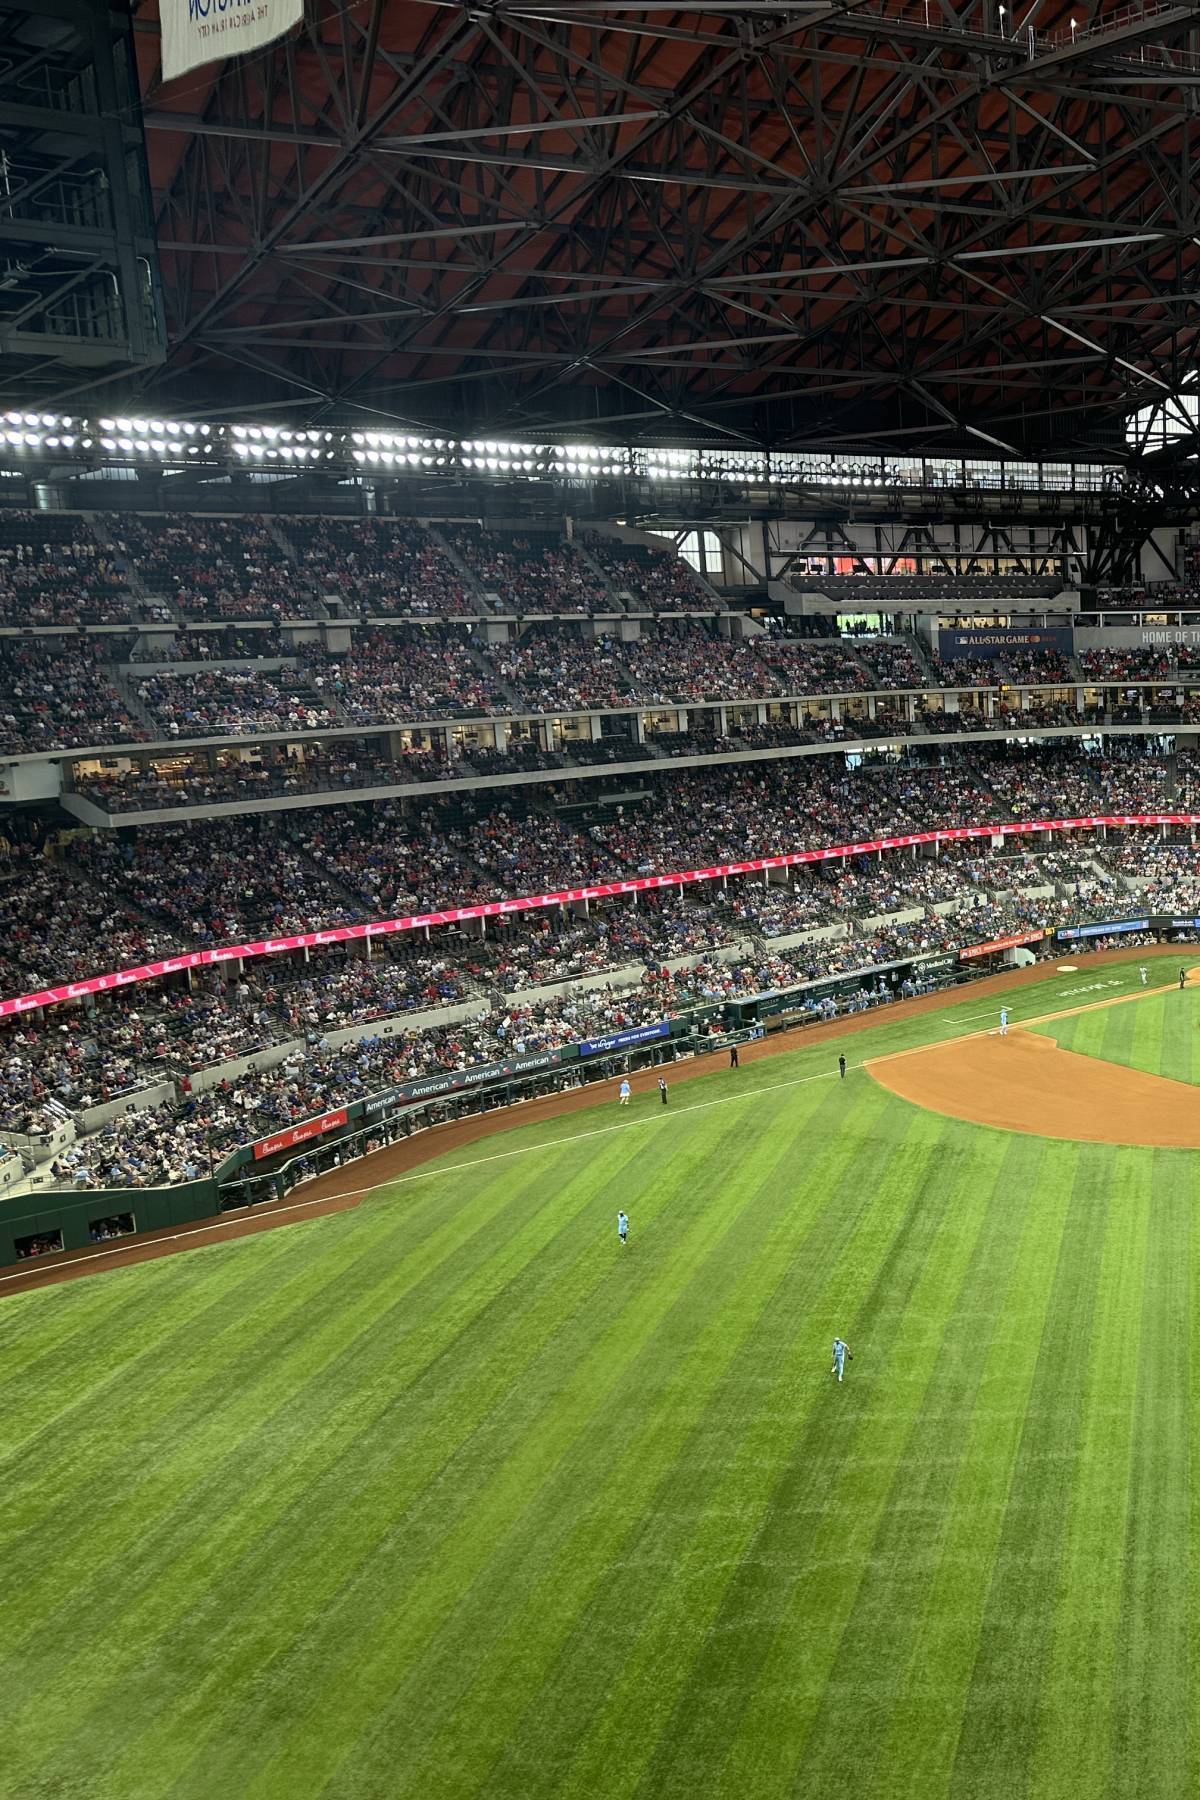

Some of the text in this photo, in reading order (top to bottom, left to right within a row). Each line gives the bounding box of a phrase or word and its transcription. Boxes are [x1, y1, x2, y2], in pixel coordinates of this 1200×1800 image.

[1006, 634, 1029, 644] GAME
[1142, 631, 1171, 643] HOME
[1175, 631, 1189, 643] OF
[597, 1038, 616, 1050] Kroger
[515, 1056, 549, 1070] American
[464, 1068, 500, 1083] American
[411, 1081, 449, 1096] American
[366, 1095, 396, 1112] American
